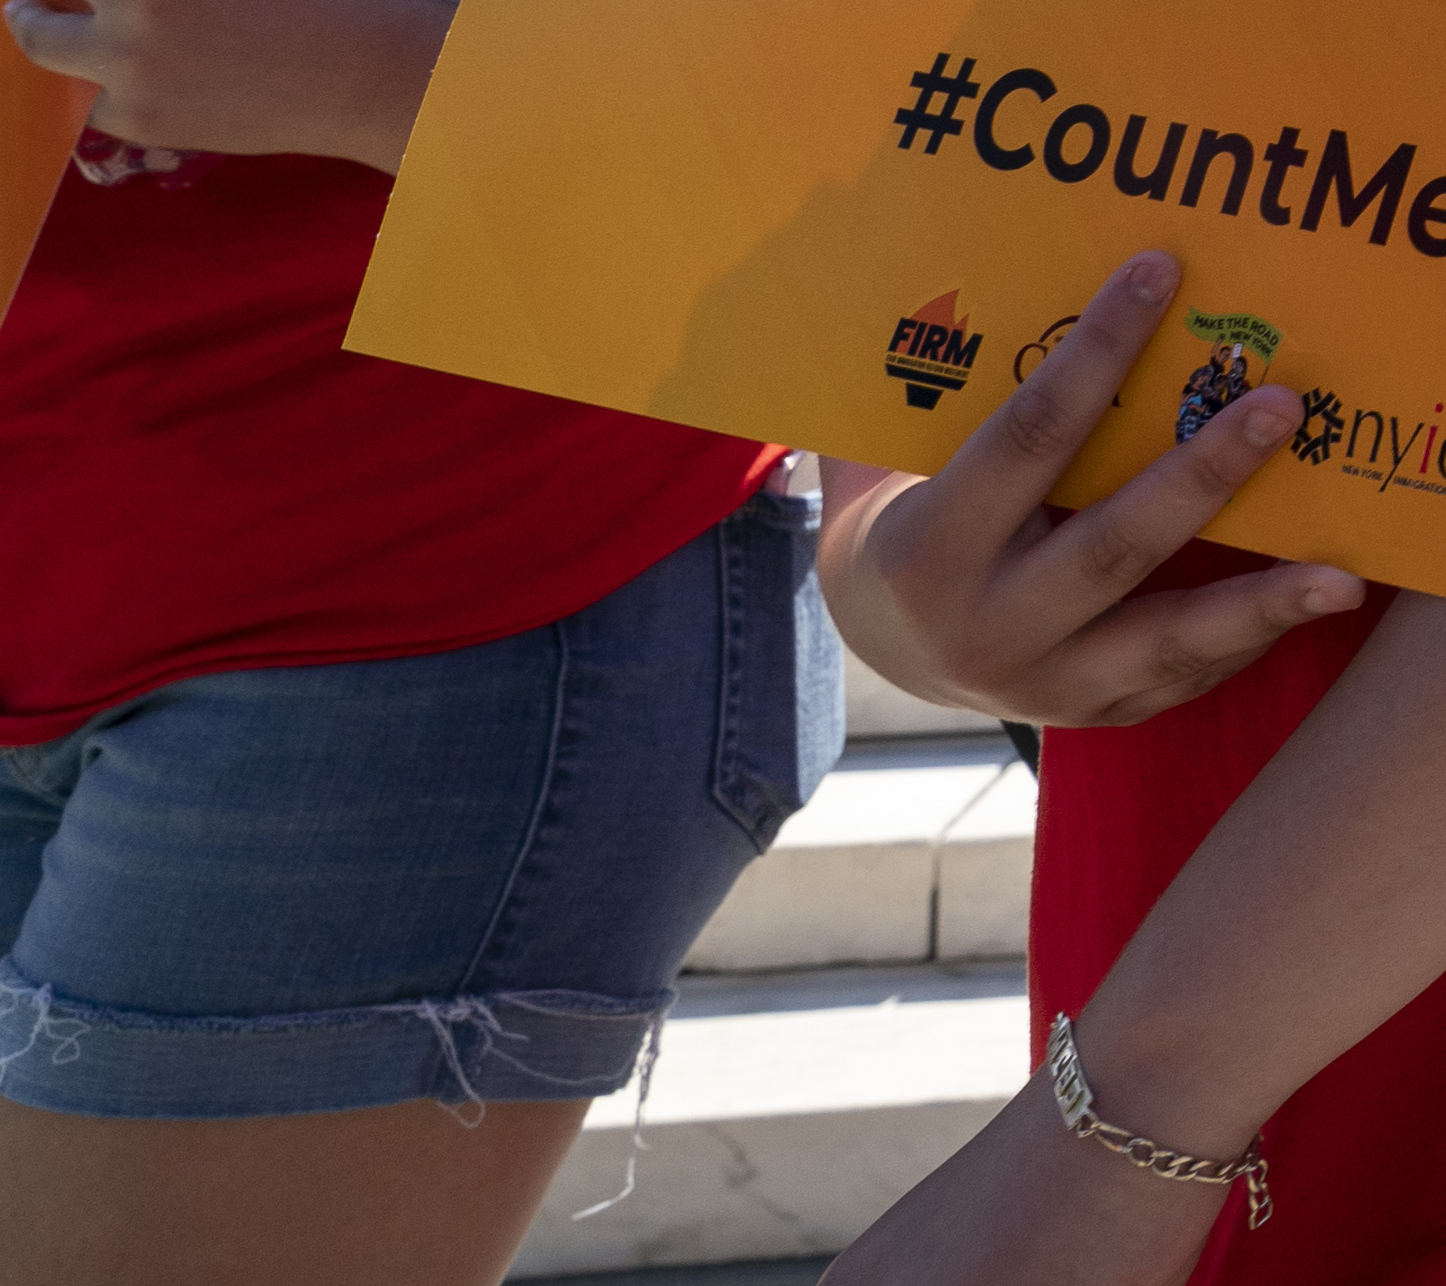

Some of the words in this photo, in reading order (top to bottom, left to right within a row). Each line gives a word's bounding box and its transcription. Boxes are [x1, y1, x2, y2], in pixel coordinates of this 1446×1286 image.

[888, 317, 984, 370] FIRM
[1193, 315, 1224, 330] MAKE
[1226, 317, 1249, 329] THE
[1250, 320, 1279, 346] ROAD
[1230, 331, 1253, 342] NEW
